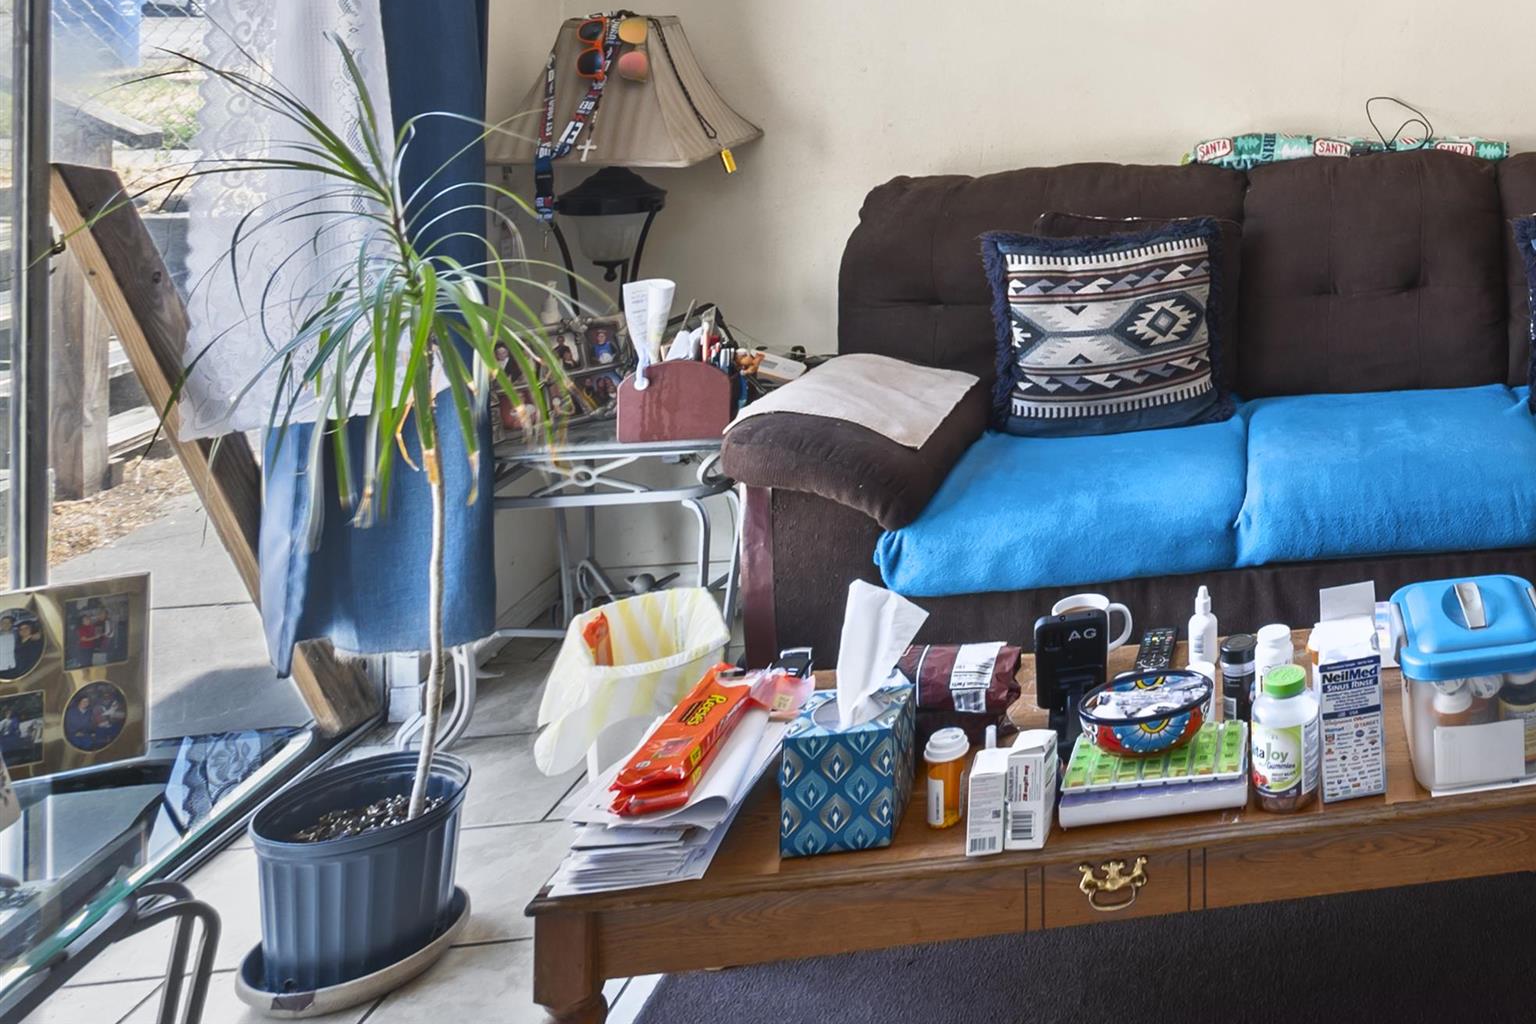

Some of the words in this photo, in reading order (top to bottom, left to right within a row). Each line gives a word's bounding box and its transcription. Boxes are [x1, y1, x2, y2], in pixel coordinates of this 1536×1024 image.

[1199, 140, 1228, 158] SANTA
[1322, 665, 1378, 685] NeilMed
[1326, 682, 1350, 693] SINUS
[1351, 678, 1374, 689] RINSE
